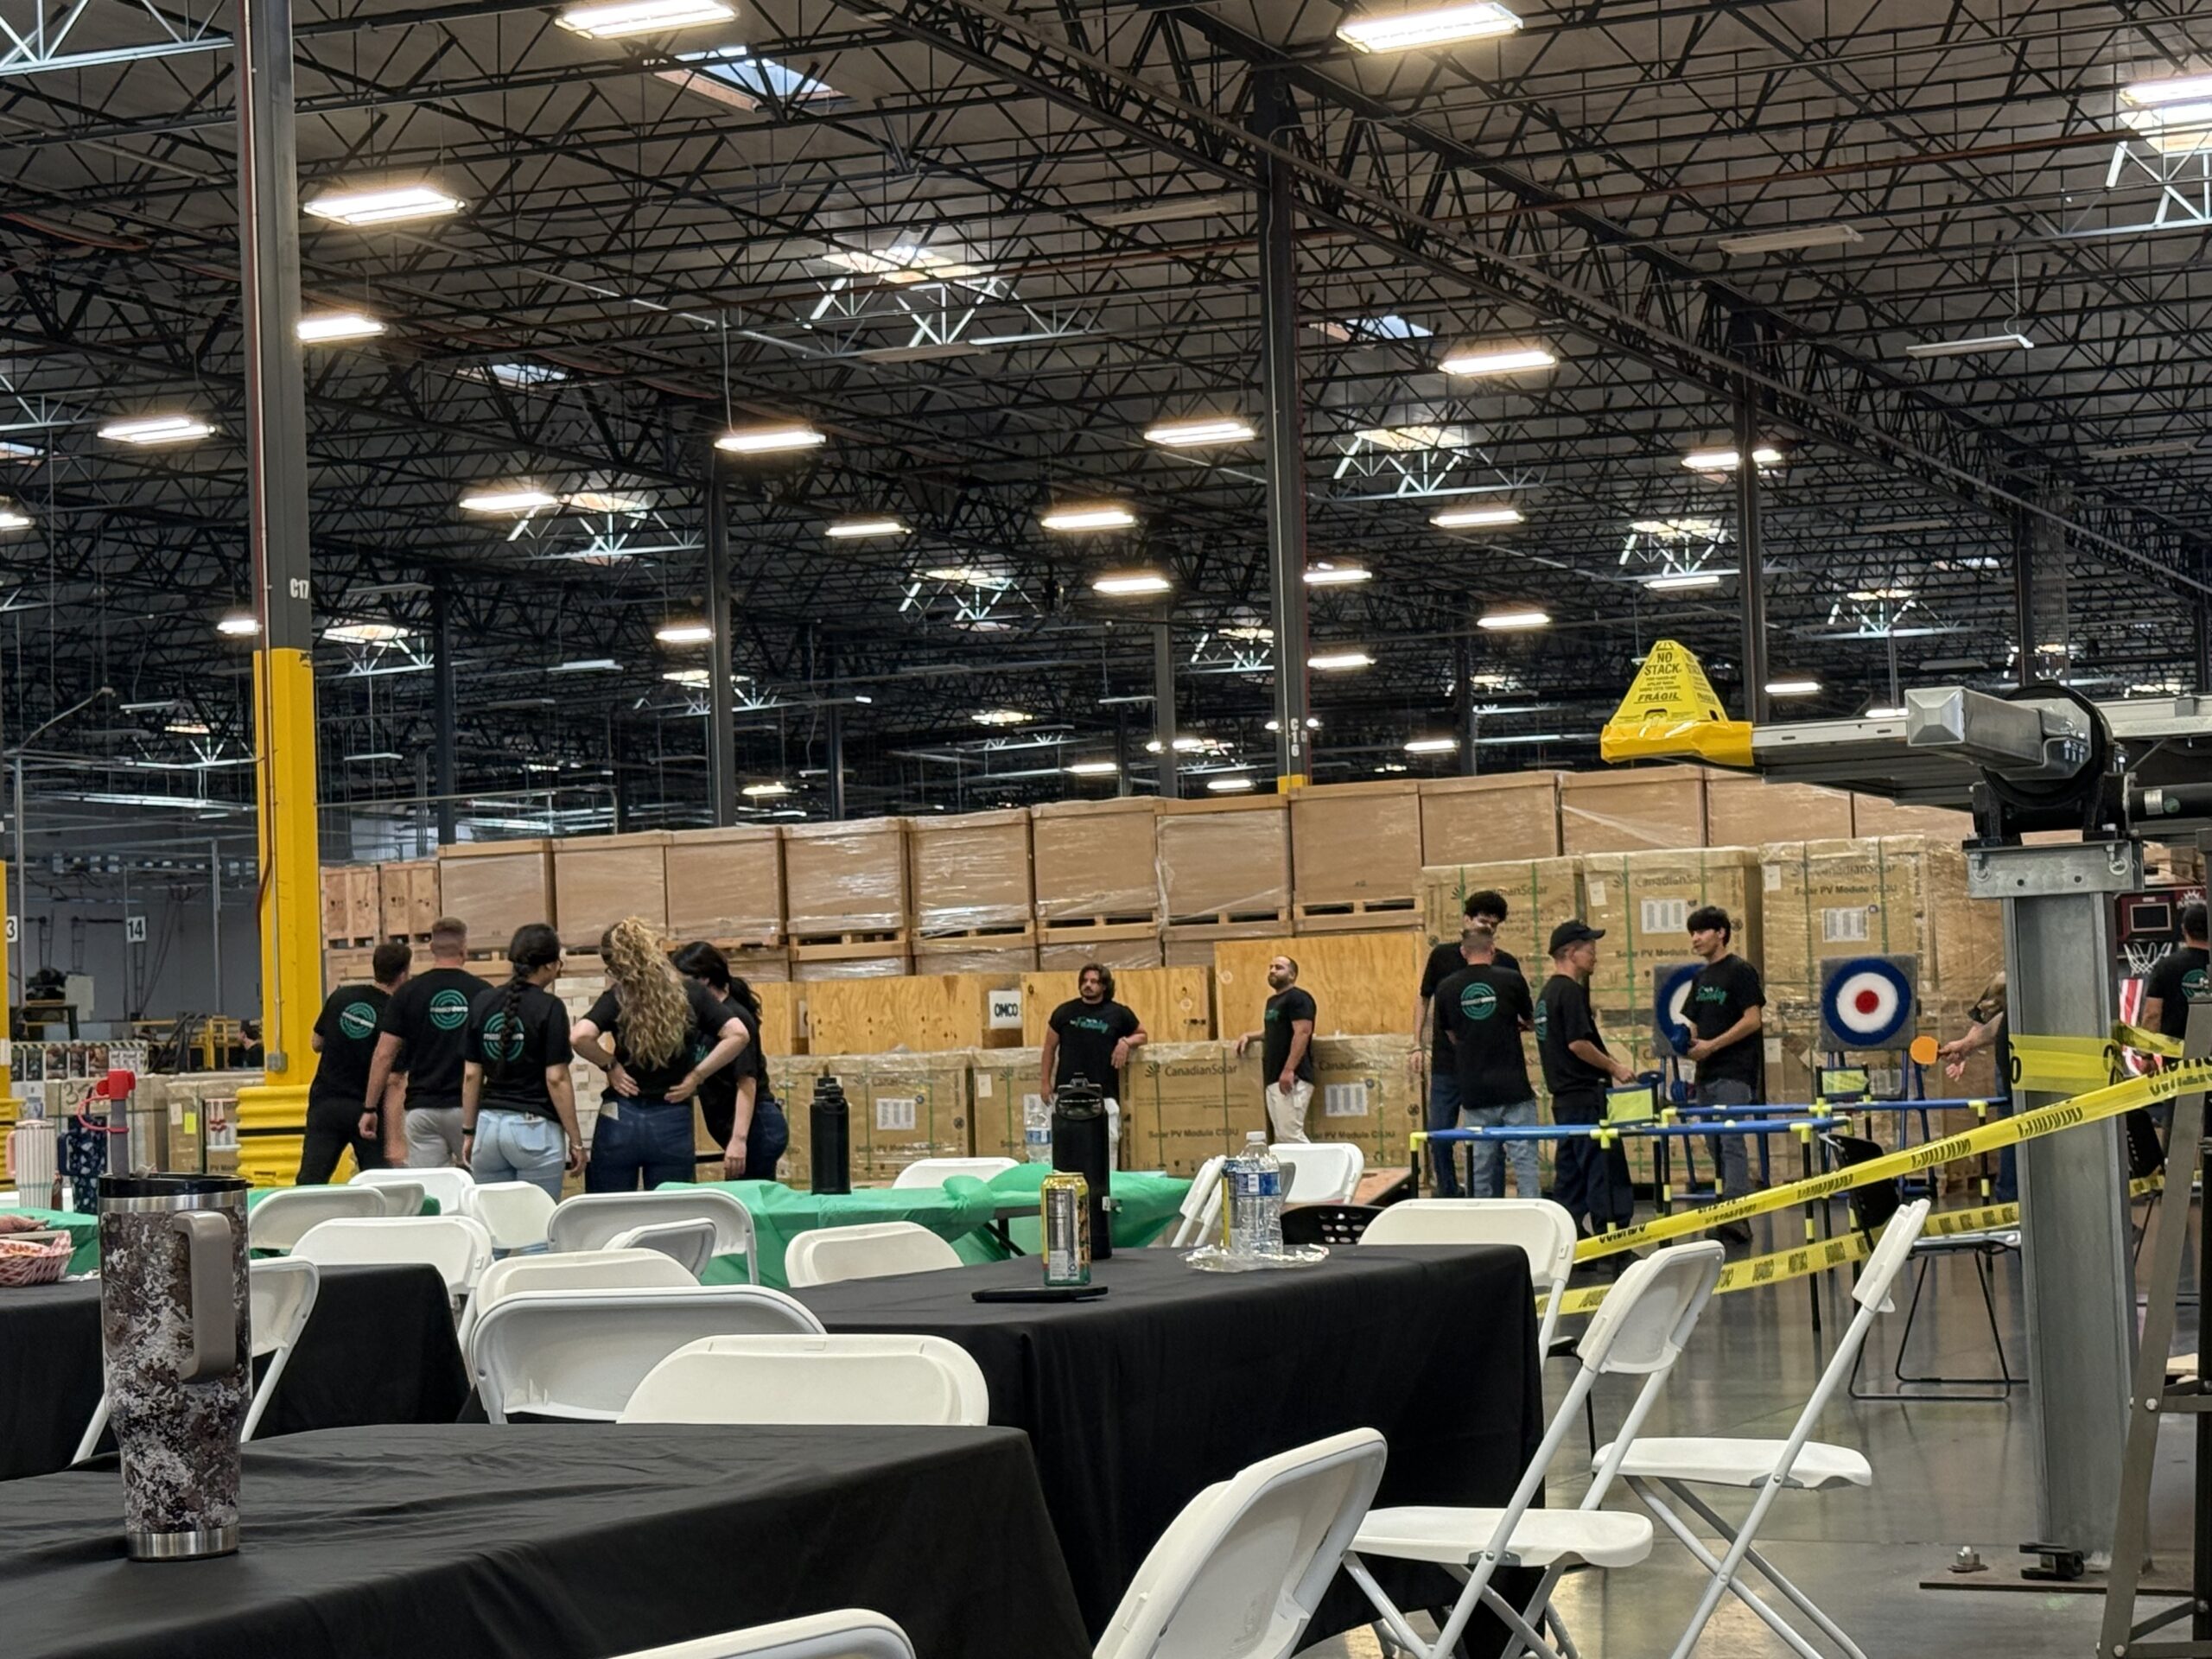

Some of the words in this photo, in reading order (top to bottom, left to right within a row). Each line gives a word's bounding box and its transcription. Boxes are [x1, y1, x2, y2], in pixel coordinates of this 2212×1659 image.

[289, 578, 309, 600] C17
[1656, 652, 1673, 663] NO
[1794, 887, 1817, 895] Soar
[6, 919, 16, 939] 3
[129, 919, 143, 938] 14
[995, 1002, 1018, 1017] OMCO
[1165, 1063, 1237, 1077] CanadianSoar
[1147, 1130, 1168, 1139] Soar
